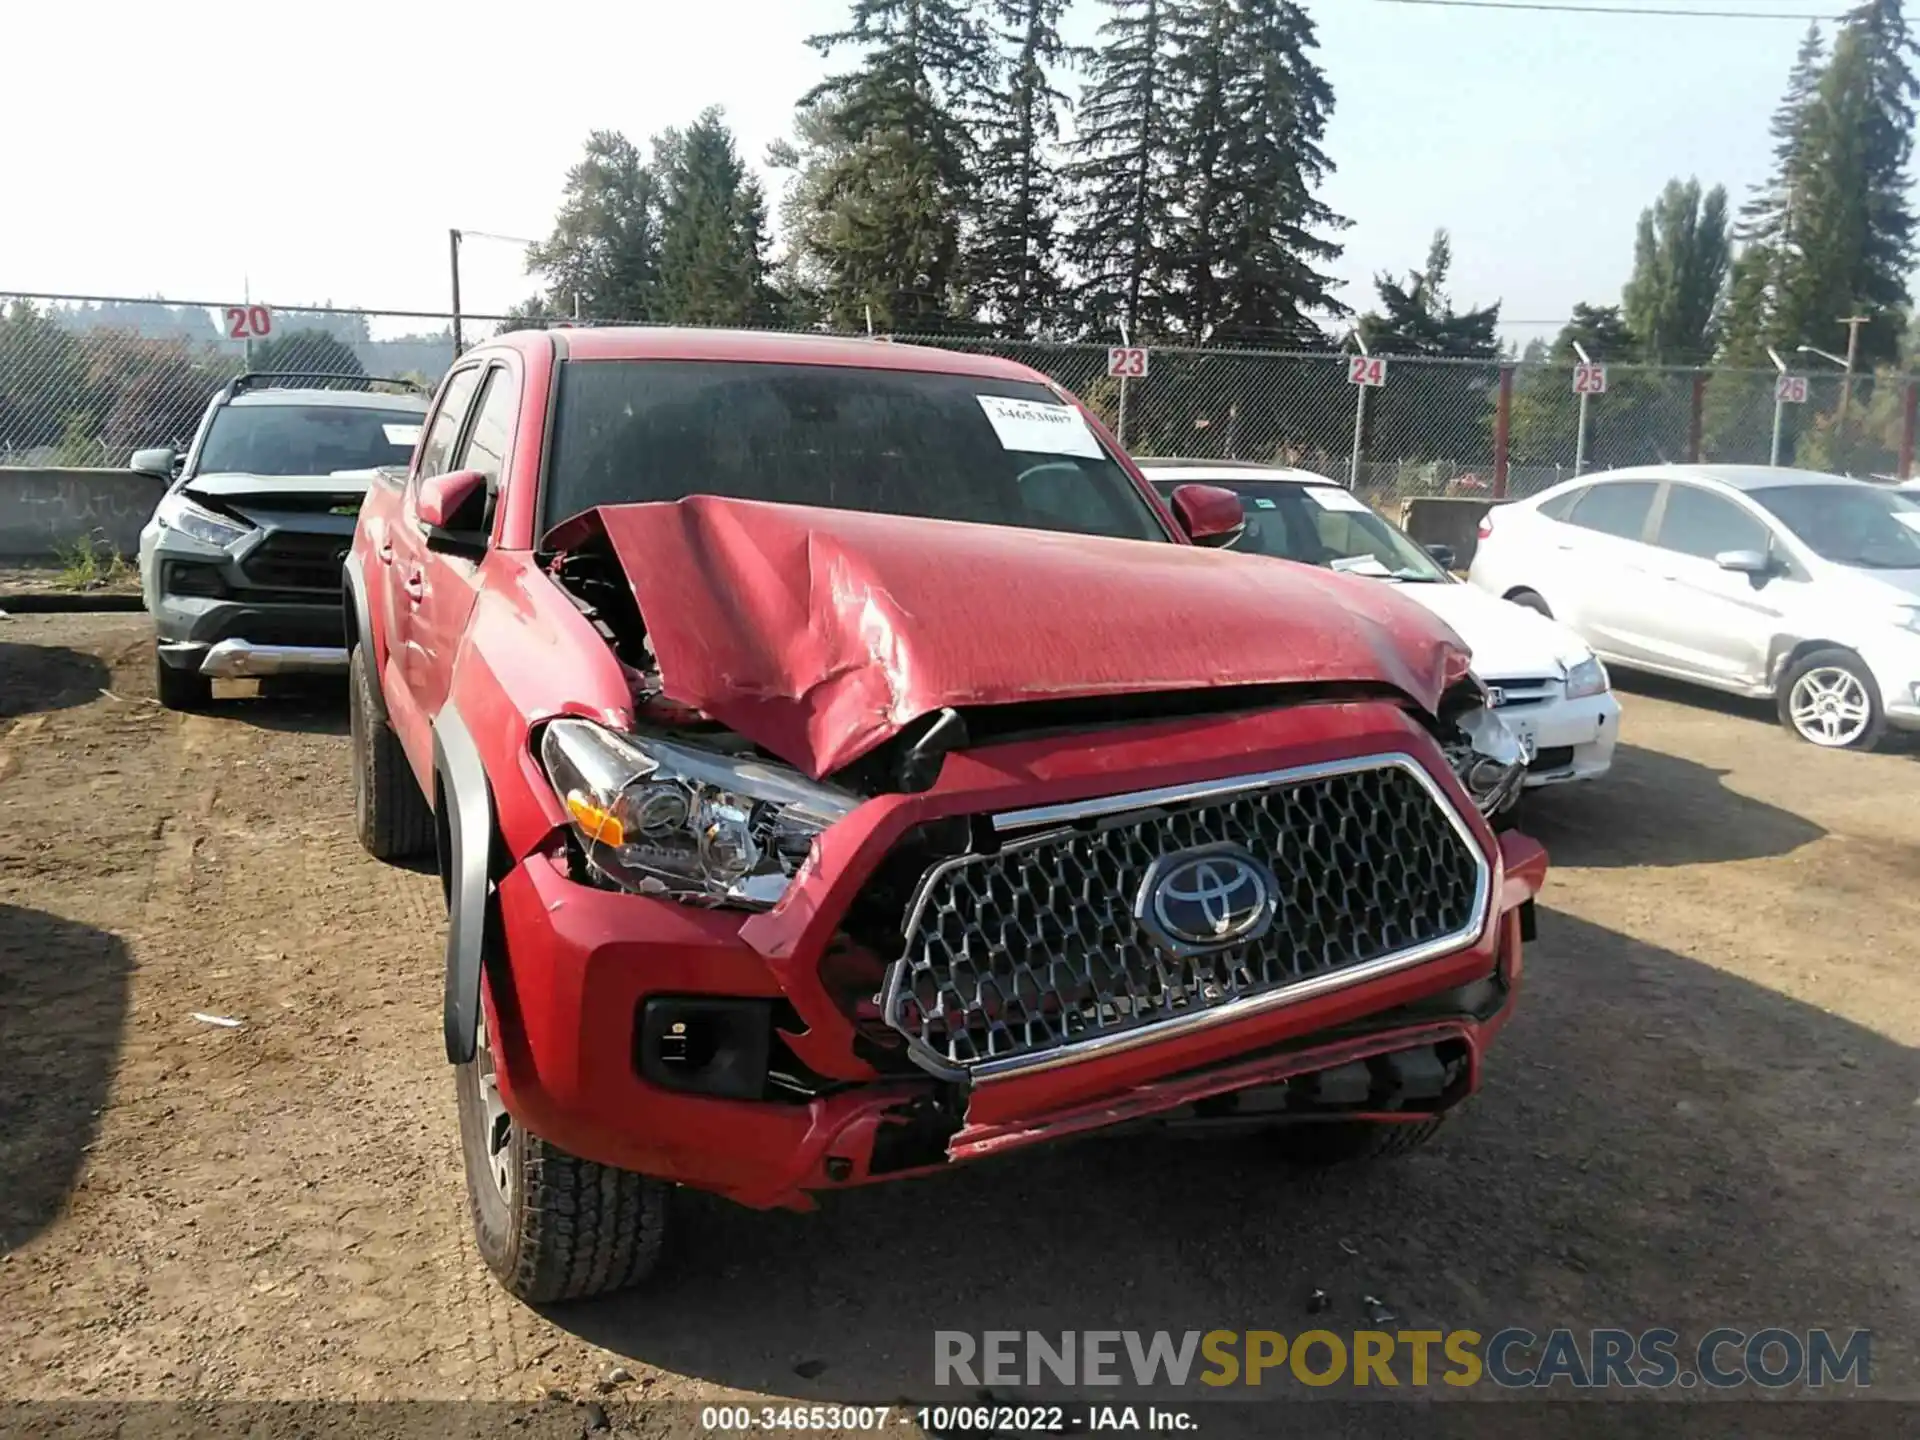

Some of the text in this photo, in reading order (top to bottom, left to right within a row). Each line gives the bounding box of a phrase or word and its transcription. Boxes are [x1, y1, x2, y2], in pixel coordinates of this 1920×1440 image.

[227, 305, 271, 338] 20
[1111, 349, 1144, 374] 23
[1351, 359, 1381, 384] 24
[1575, 368, 1602, 391] 25
[1778, 378, 1804, 401] 26
